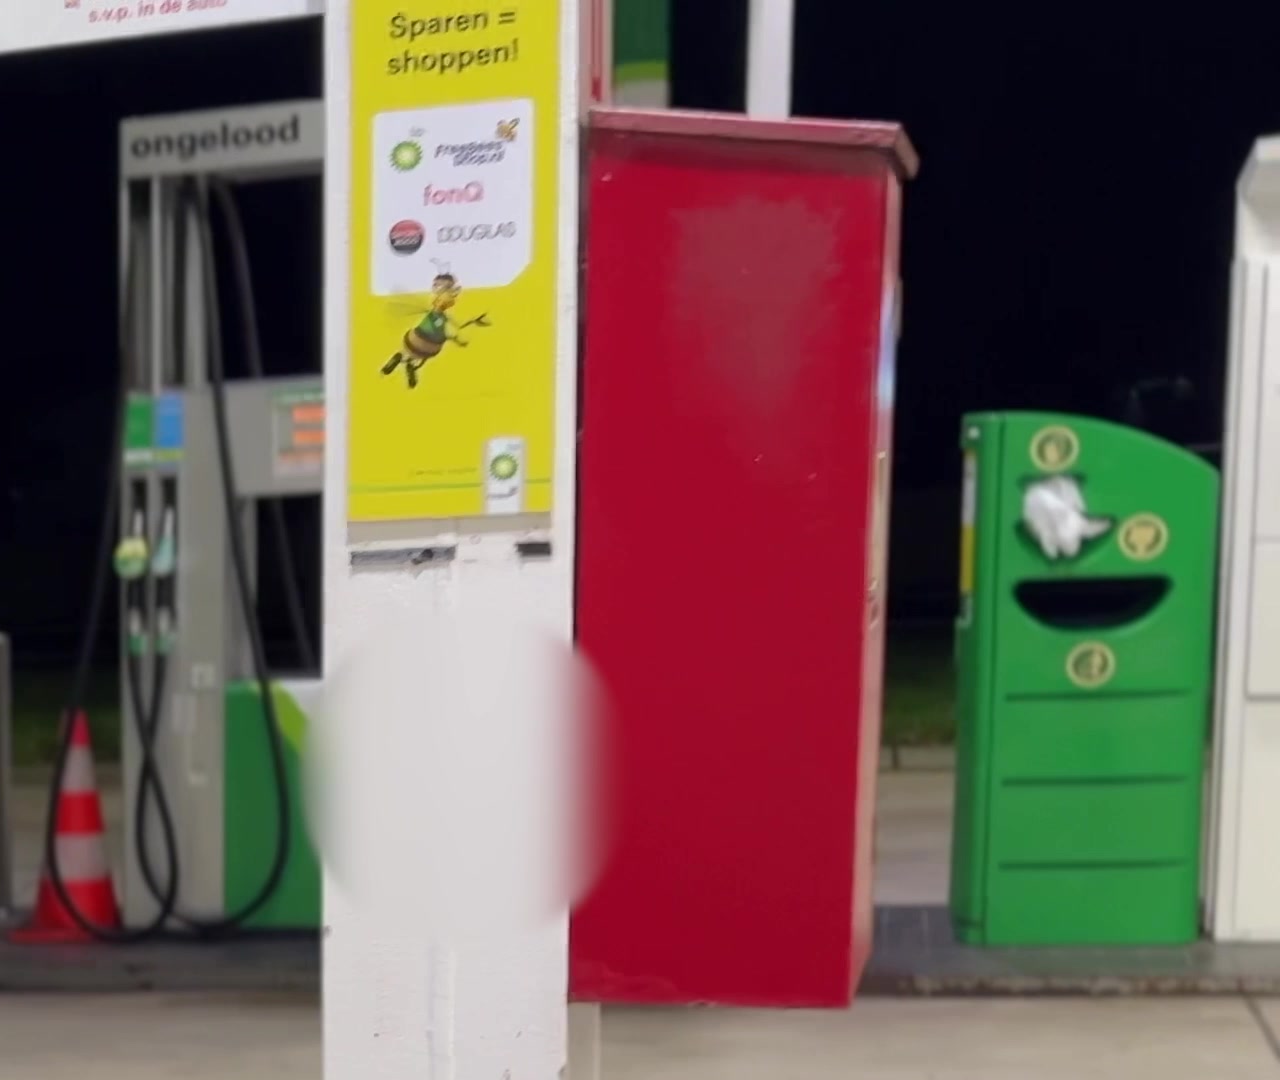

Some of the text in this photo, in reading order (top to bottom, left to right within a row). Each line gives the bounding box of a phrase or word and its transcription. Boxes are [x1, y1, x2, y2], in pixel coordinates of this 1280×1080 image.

[137, 3, 154, 17] in
[159, 0, 182, 14] de
[389, 11, 516, 42] Sparen =
[386, 38, 520, 75] shoppen!
[131, 115, 300, 160] ongelood
